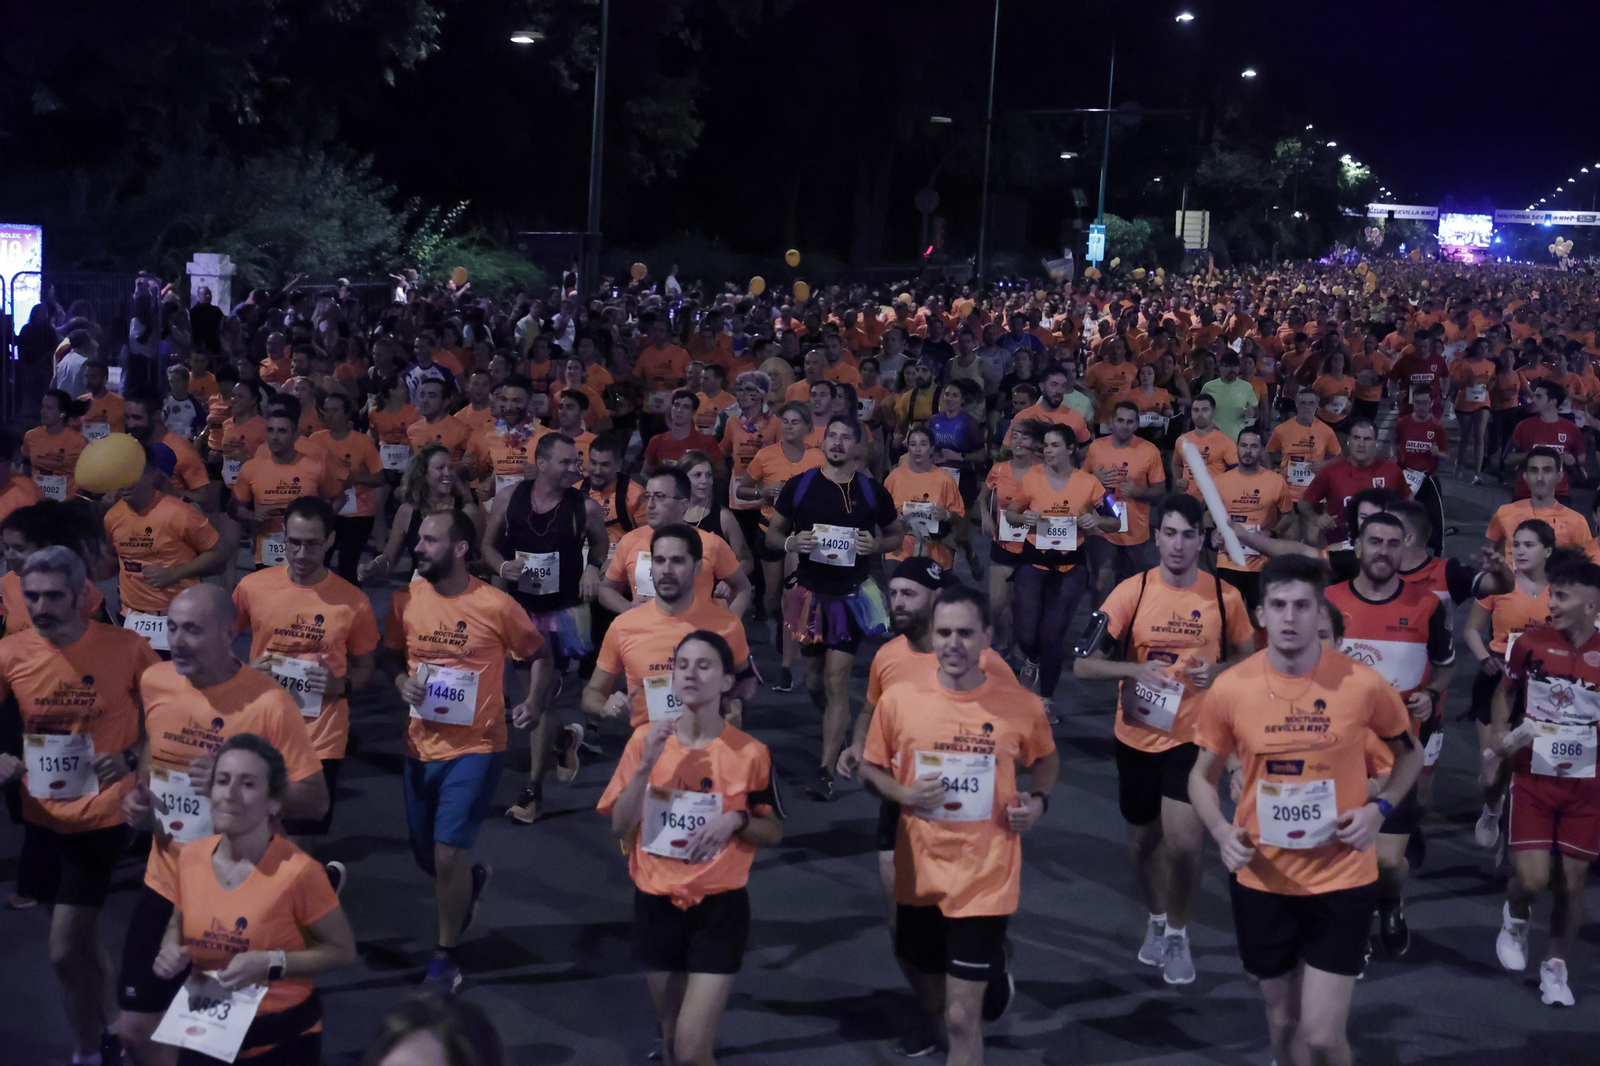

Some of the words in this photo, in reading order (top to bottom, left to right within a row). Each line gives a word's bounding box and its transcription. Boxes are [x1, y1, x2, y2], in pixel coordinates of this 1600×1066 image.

[1292, 469, 1311, 477] 21913
[1047, 527, 1067, 537] 6856
[268, 544, 287, 553] 783
[820, 536, 850, 552] 14020
[524, 566, 552, 578] 21894
[133, 621, 163, 632] 17511
[290, 623, 326, 635] NOCTURNA
[1150, 625, 1182, 634] SEVILLA
[1183, 628, 1202, 636] KH7
[1167, 620, 1203, 629] NOCTURNA
[274, 628, 305, 638] SEVILLA
[305, 633, 324, 642] KH7
[418, 635, 448, 644] SEVILLA
[448, 639, 467, 647] KH7
[433, 630, 469, 640] NOCTURNA
[1341, 646, 1353, 656] lub
[649, 663, 675, 671] SEVIL
[427, 684, 465, 702] 14486
[1134, 683, 1167, 708] 20971
[34, 697, 73, 706] SEVILLA
[74, 698, 96, 706] KH7
[1265, 724, 1305, 733] SEVILLA
[1306, 724, 1330, 733] KH7
[181, 727, 224, 743] NOCTURNA
[953, 736, 995, 746] NOCTURNA
[163, 731, 198, 747] SEVILLA
[199, 740, 221, 752] KH7
[934, 741, 971, 752] SEVILLA
[972, 746, 994, 755] KH7
[1551, 742, 1583, 756] 8966
[39, 756, 80, 772] 13157
[941, 777, 979, 793] 6443
[161, 792, 200, 816] 13162
[1272, 804, 1321, 821] 20965
[203, 930, 250, 945] NOCTURNA
